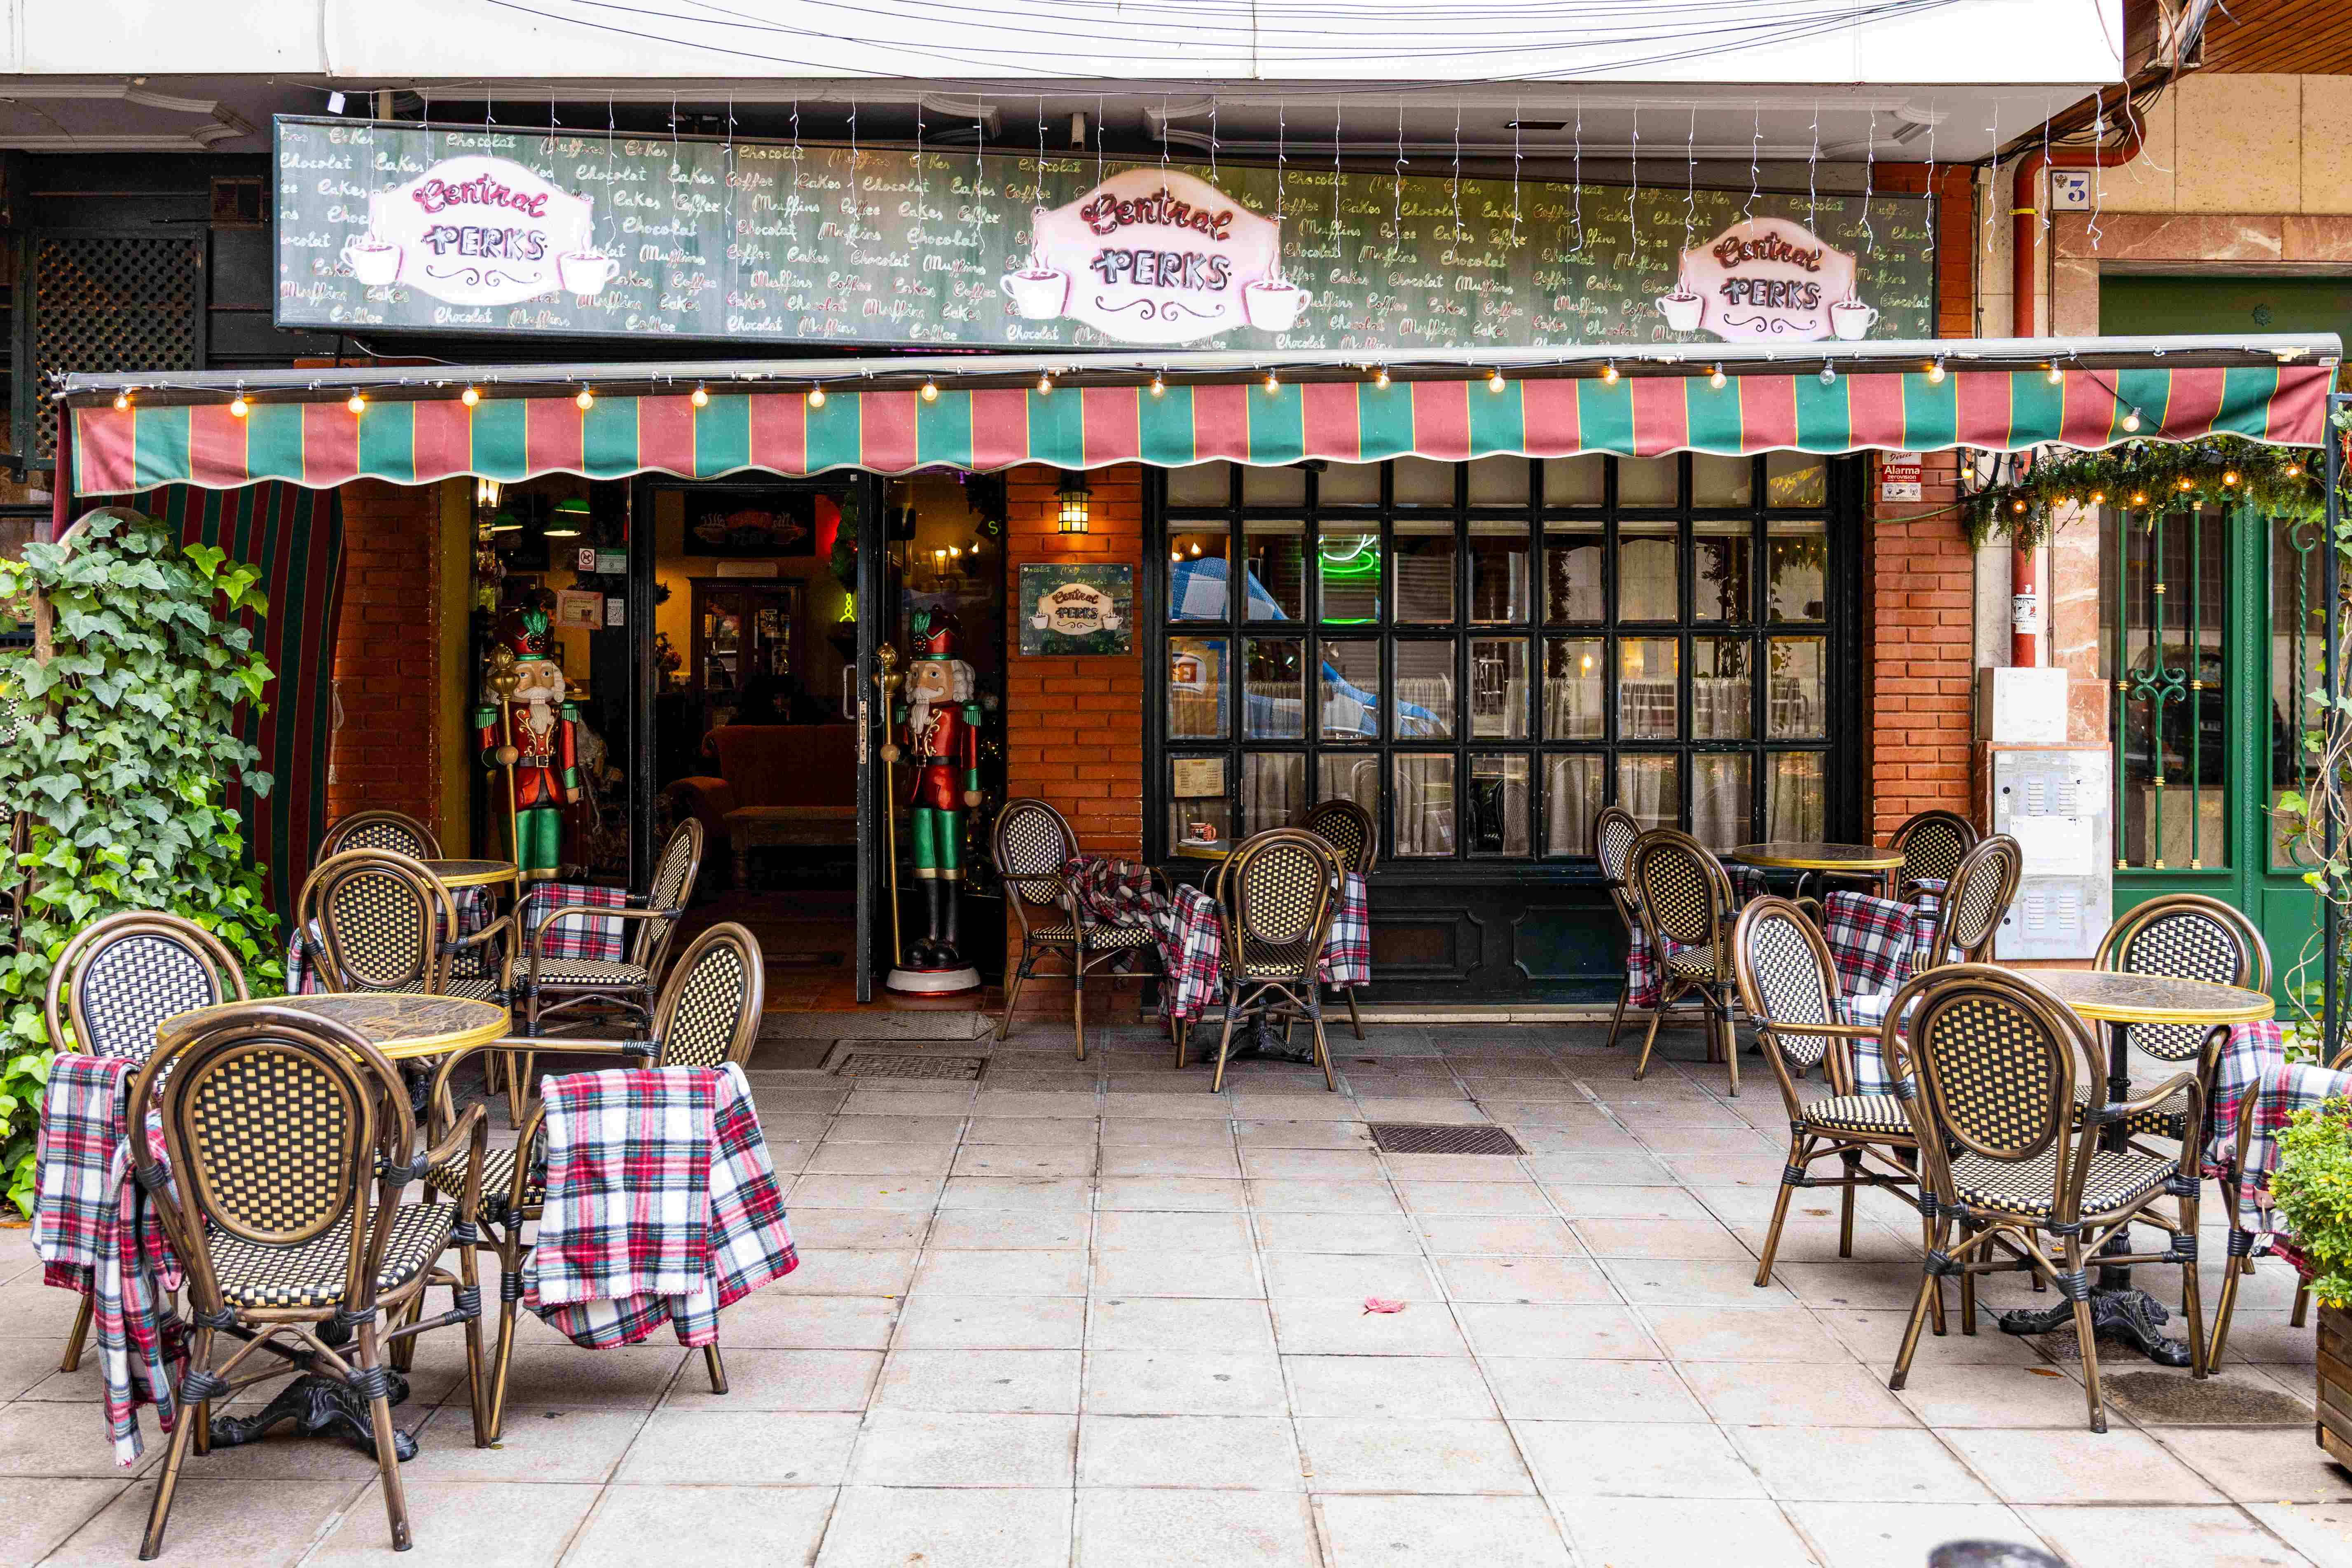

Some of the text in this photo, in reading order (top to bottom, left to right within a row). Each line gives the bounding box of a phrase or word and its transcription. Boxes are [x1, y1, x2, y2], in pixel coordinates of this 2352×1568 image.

[446, 133, 517, 148] Chocolat
[540, 136, 605, 158] Muffins
[739, 145, 805, 160] Chocolat
[1018, 158, 1081, 173] Chocolat
[280, 152, 424, 173] Chocolat Cakes
[318, 179, 367, 199] Cakes
[413, 173, 548, 217] Central
[577, 165, 647, 182] Chocolat
[668, 165, 715, 185] Cakes
[725, 172, 773, 191] Coffee
[798, 173, 840, 189] Cakes
[863, 176, 930, 192] Chocolat
[950, 176, 995, 196] Cakes
[1005, 184, 1051, 203] Coffee
[1288, 171, 1348, 186] Chocolat
[1789, 198, 1844, 211] Chocolat
[2069, 180, 2085, 201] 3
[614, 190, 660, 210] Cakes
[676, 193, 720, 218] Coffee
[752, 194, 820, 219] Muffins
[839, 198, 880, 216] Coffee
[899, 201, 943, 220] Cakes
[957, 206, 1001, 227] Coffee
[1080, 186, 1233, 241] Central
[1275, 198, 1318, 214] Coffee
[1340, 199, 1381, 215] Cakes
[1401, 202, 1462, 217] Chocolat
[1481, 201, 1523, 221] Cakes
[424, 225, 546, 261] PERKS
[623, 217, 978, 246] Chocolat Chocolat Muffins Chocolat
[1299, 218, 1360, 241] Muffins
[1433, 226, 1474, 243] Cakes
[640, 244, 706, 267] Muffins
[727, 243, 771, 267] Coffee
[787, 246, 830, 264] Cakes
[851, 249, 910, 267] Chocolat
[923, 254, 986, 278] Muffins
[1284, 242, 1340, 257] Chocolat
[1359, 245, 1417, 267] Muffins
[1441, 250, 1507, 268] Chocolat
[1542, 248, 1595, 266] Chocolat
[1713, 232, 1823, 271] Central
[1094, 249, 1231, 291] PERKS
[1330, 269, 1370, 286] Cakes
[1388, 272, 1443, 288] Chocolat
[1455, 276, 1514, 297] Muffins
[1533, 271, 1573, 291] Coffee
[1587, 275, 1624, 291] Cakes
[363, 286, 410, 303] Cakes
[672, 271, 717, 295] Coffee
[750, 270, 812, 293] Muffins
[827, 271, 872, 297] Coffee
[893, 277, 936, 297] Cakes
[953, 281, 996, 305] Coffee
[1721, 278, 1819, 311] PERKS
[576, 290, 642, 315] Muffins
[659, 293, 701, 312] Cakes
[726, 292, 766, 310] Cakes
[785, 296, 847, 312] Chocolat
[863, 299, 925, 323] Muffins
[940, 302, 982, 321] Cakes
[1367, 292, 1408, 316] Coffee
[1427, 297, 1467, 316] Cakes
[1484, 300, 1523, 323] Coffee
[1554, 295, 1608, 318] Muffins
[330, 304, 382, 324] Coffee
[434, 307, 493, 323] Chocolat
[508, 309, 570, 328] Muffins
[626, 314, 675, 331] Coffee
[726, 316, 783, 333] Chocolat
[798, 316, 857, 337] Muffins
[910, 323, 957, 340] Coffee
[1006, 324, 1059, 341] Chocolat
[1330, 314, 1385, 332] Chocolat
[1399, 318, 1457, 341] Muffins
[1470, 320, 1509, 339] Cakes
[1532, 316, 1568, 332] Cakes
[1585, 320, 1638, 337] Chocolat
[1276, 334, 1325, 349] Chocolat
[1884, 465, 1920, 475] Alarma
[1053, 588, 1099, 604] Central
[1055, 607, 1098, 619] PERKS
